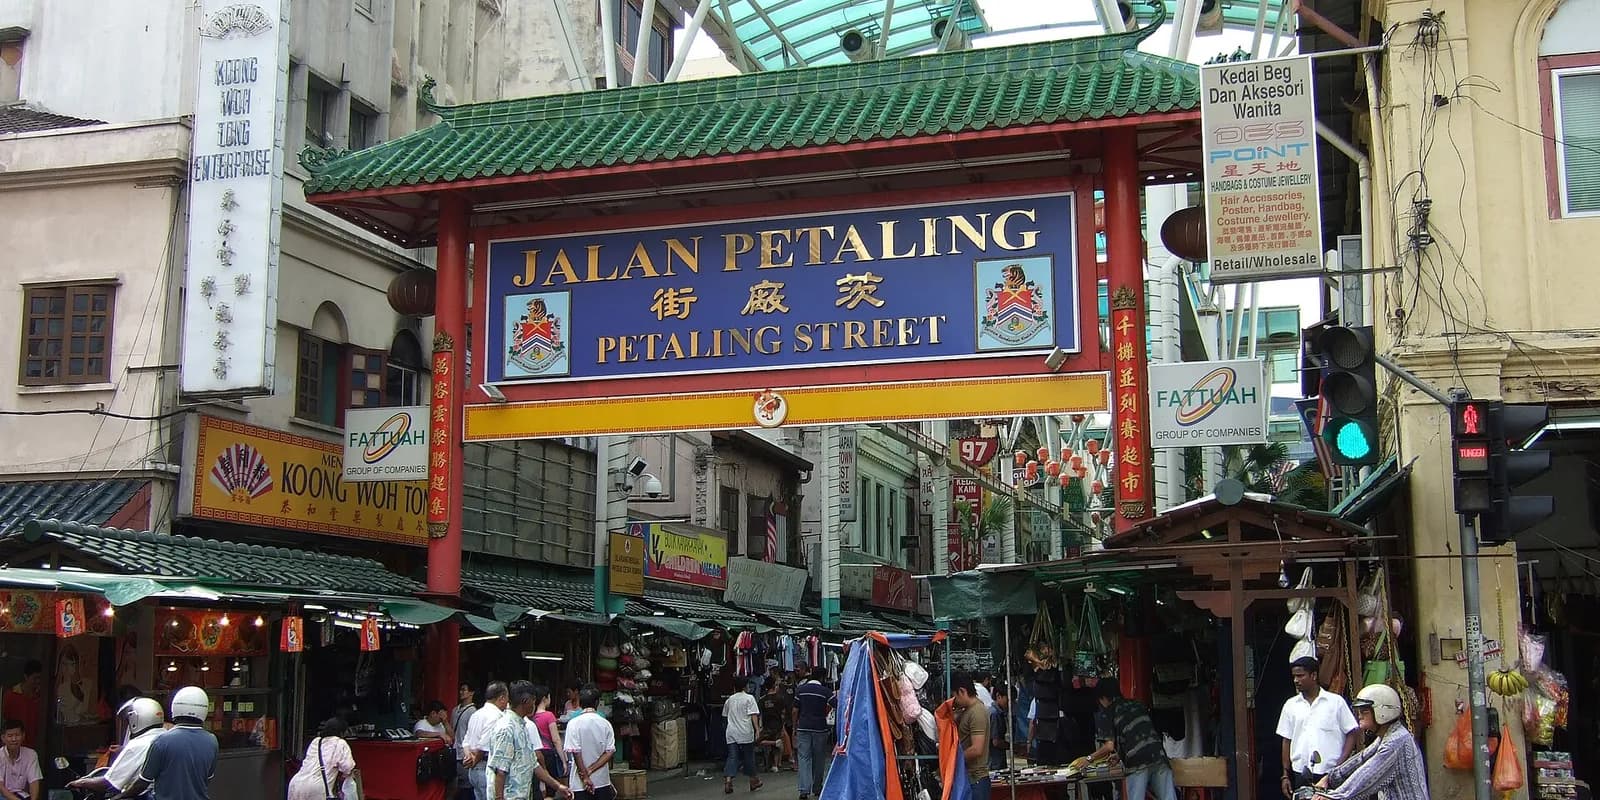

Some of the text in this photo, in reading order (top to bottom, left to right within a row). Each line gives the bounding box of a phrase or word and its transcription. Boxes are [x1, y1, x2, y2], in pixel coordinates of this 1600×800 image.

[215, 57, 258, 86] KOONG
[1220, 65, 1292, 85] Kedai Beg
[1209, 79, 1304, 104] Dan Aksesori
[221, 88, 251, 116] WOH
[1233, 101, 1282, 119] Wanita
[193, 149, 271, 182] ENTERPRISE
[1221, 161, 1302, 178] 星天地
[1211, 173, 1312, 192] HANDBAGS & COSTUME JEWELLERY
[1220, 195, 1241, 206] Hair
[1222, 206, 1256, 216] Poster,
[1217, 216, 1260, 227] Costume
[512, 208, 1041, 288] JALAN PETALING
[1214, 253, 1317, 271] Retail/Wholesale
[597, 326, 782, 364] PETALING
[794, 315, 947, 352] STREET
[1116, 315, 1140, 493] 千攤並列賽超市
[1157, 387, 1257, 408] FATTUAH
[350, 430, 425, 447] FATTUAH
[1156, 427, 1261, 440] GROUP OF COMPANIES
[962, 441, 988, 461] 97
[1460, 448, 1485, 458] TUNGGU
[346, 465, 426, 476] GROUP OF COMPANIES
[281, 461, 347, 502] KOONG
[357, 480, 398, 511] WOH
[958, 486, 977, 494] KAIN
